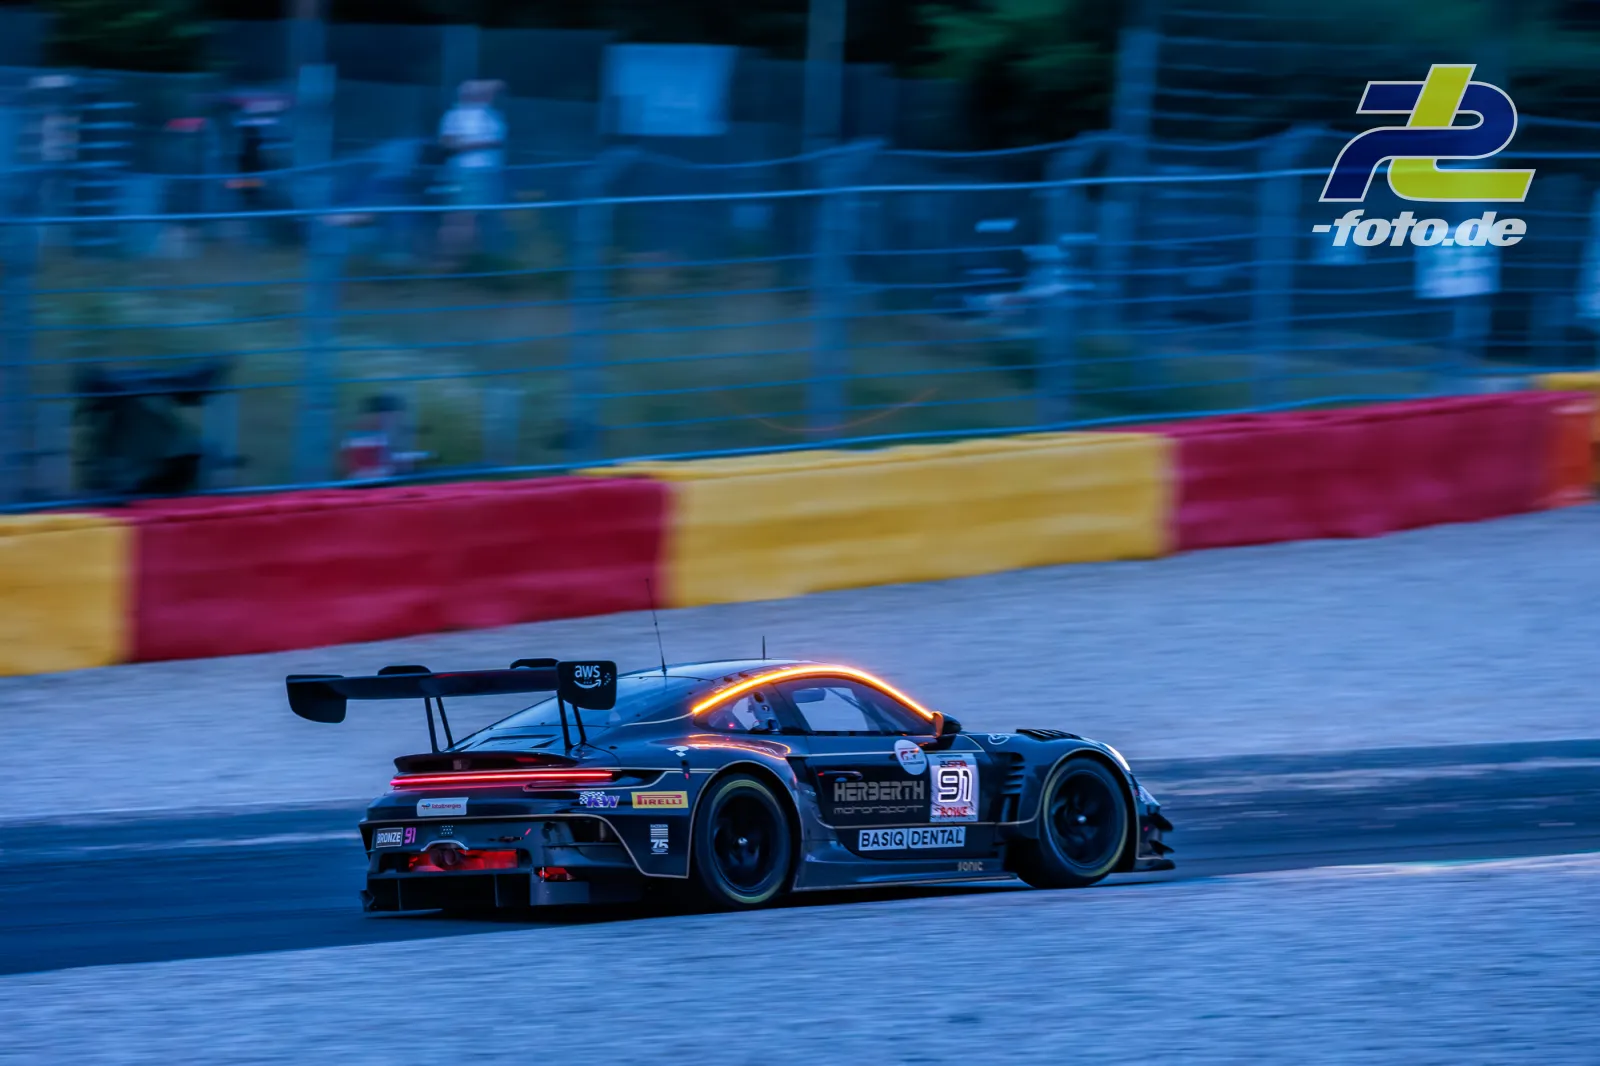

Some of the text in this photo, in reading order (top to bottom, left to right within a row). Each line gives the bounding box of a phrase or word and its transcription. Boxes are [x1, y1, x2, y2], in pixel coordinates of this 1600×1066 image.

[574, 665, 601, 678] aws
[834, 780, 925, 802] HERBERTH
[937, 767, 973, 803] 91
[636, 794, 683, 805] PIRELLI
[377, 831, 402, 844] BRONZE
[404, 827, 417, 844] 91
[861, 828, 963, 848] BASIQ DENTAL
